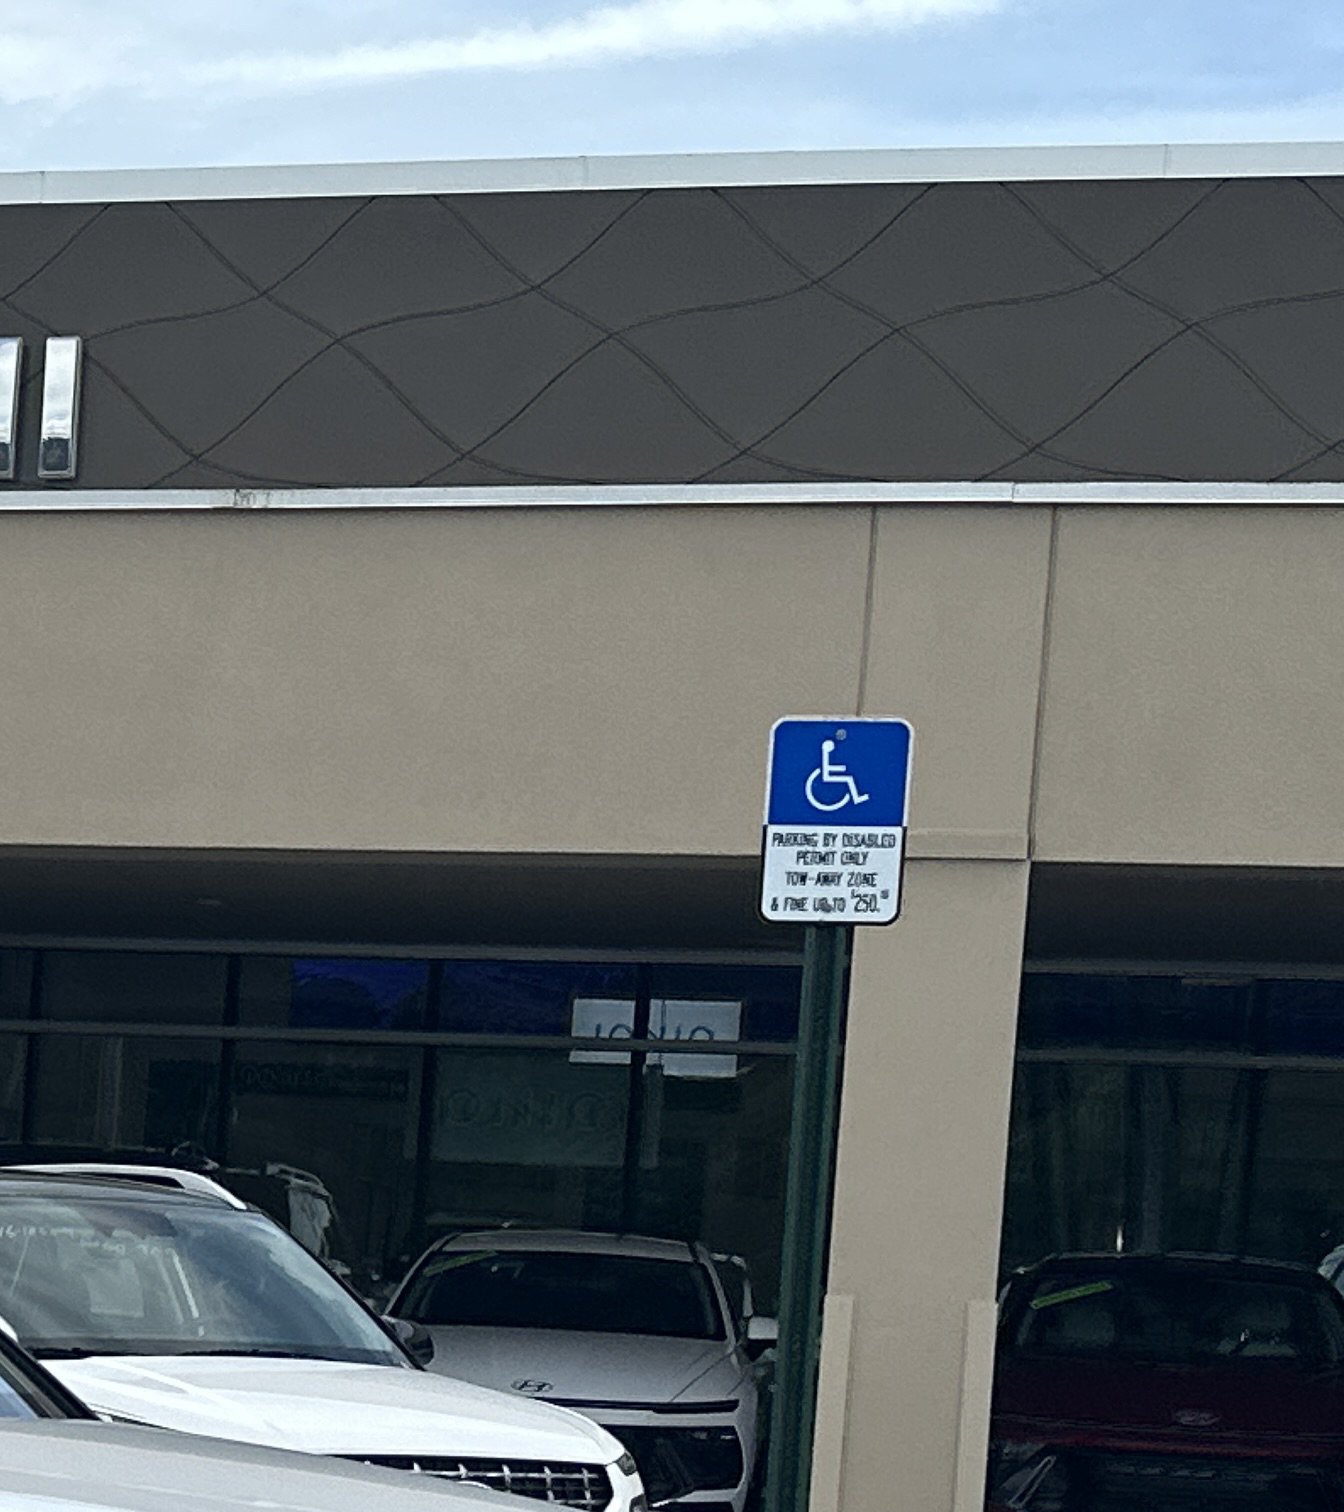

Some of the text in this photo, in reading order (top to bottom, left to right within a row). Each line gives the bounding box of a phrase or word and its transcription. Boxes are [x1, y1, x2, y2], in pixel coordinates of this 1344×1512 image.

[822, 832, 838, 848] BY
[842, 832, 896, 848] DISABLED
[796, 850, 837, 865] PERMIT
[847, 872, 878, 887] ZONE
